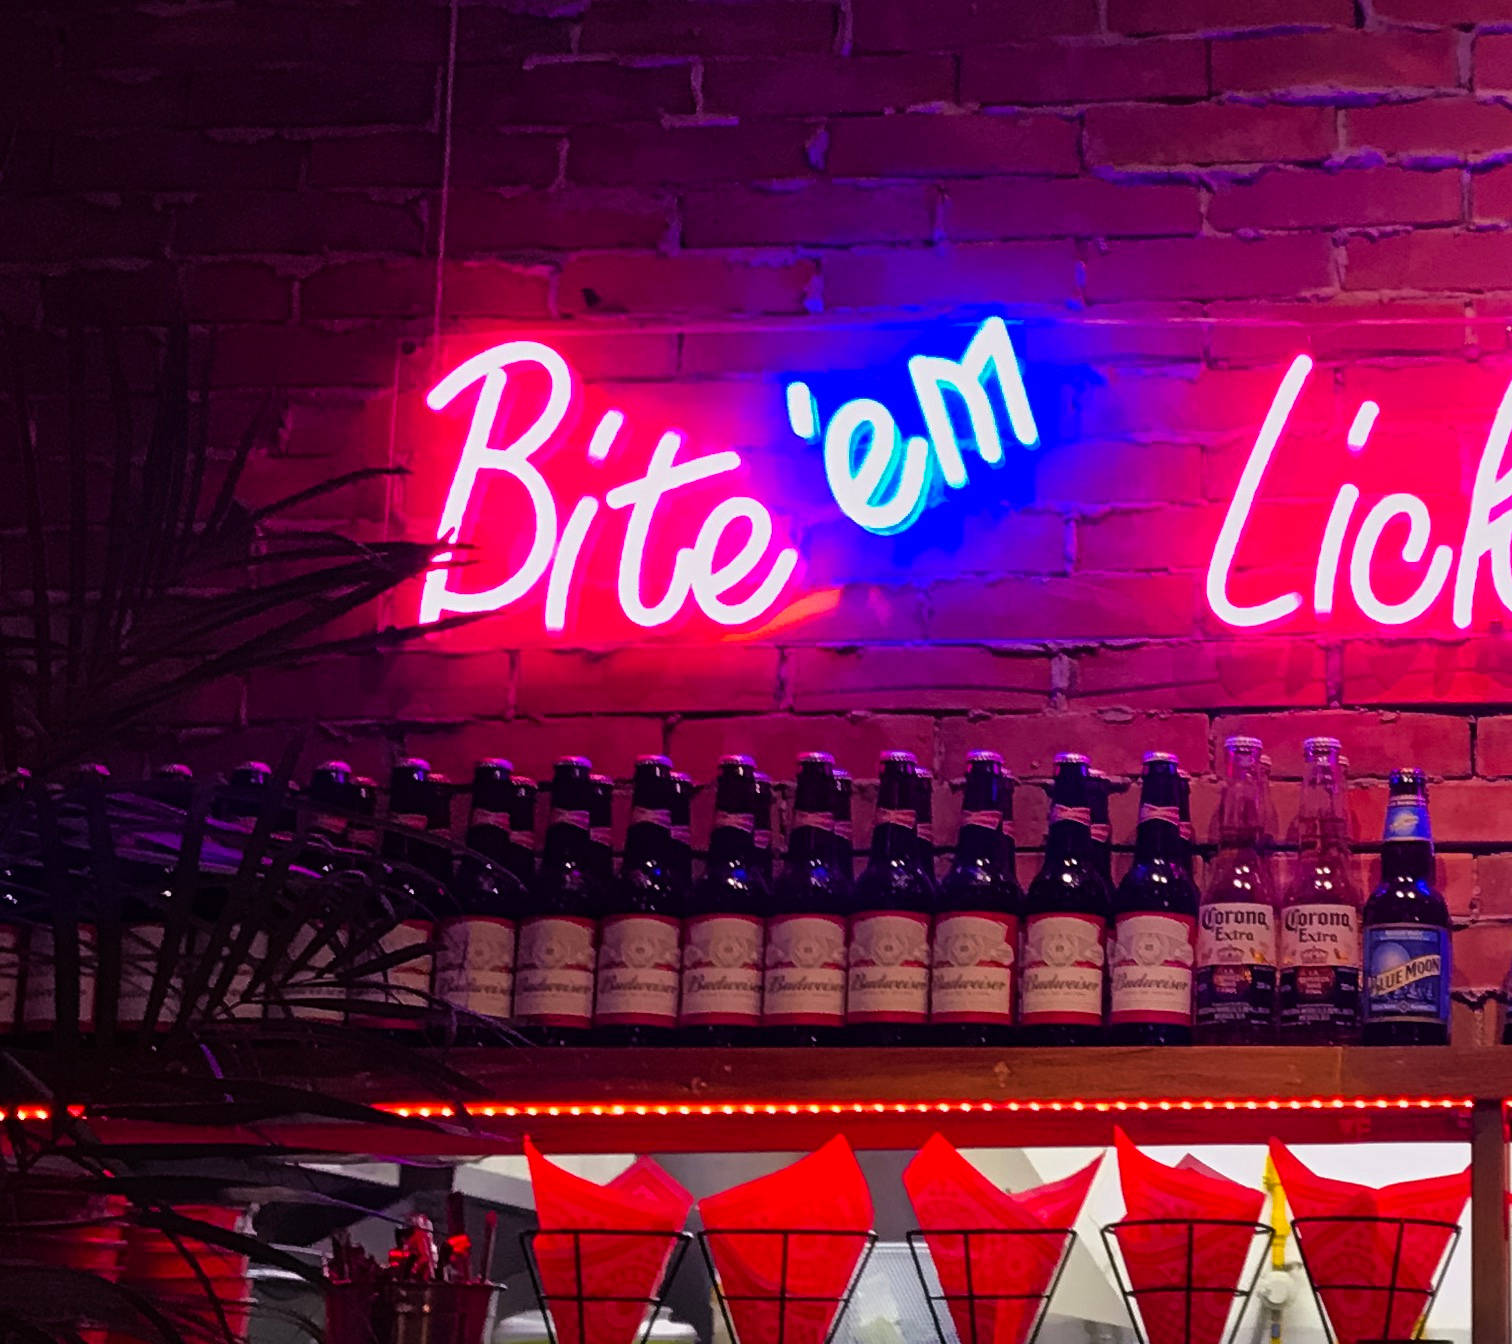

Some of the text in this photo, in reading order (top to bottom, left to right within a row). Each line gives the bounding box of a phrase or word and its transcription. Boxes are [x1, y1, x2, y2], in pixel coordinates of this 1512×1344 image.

[420, 340, 798, 632] Bite
[1202, 907, 1270, 930] Corona
[1285, 907, 1353, 930] Corona
[1215, 928, 1253, 942] Extra
[1299, 928, 1337, 942] Extra
[852, 974, 927, 991] Budweiser
[933, 974, 1006, 991] Budweiser
[1024, 974, 1100, 991] Budweiser
[1115, 973, 1189, 991] Budweiser
[1368, 957, 1440, 996] BLUE MOON
